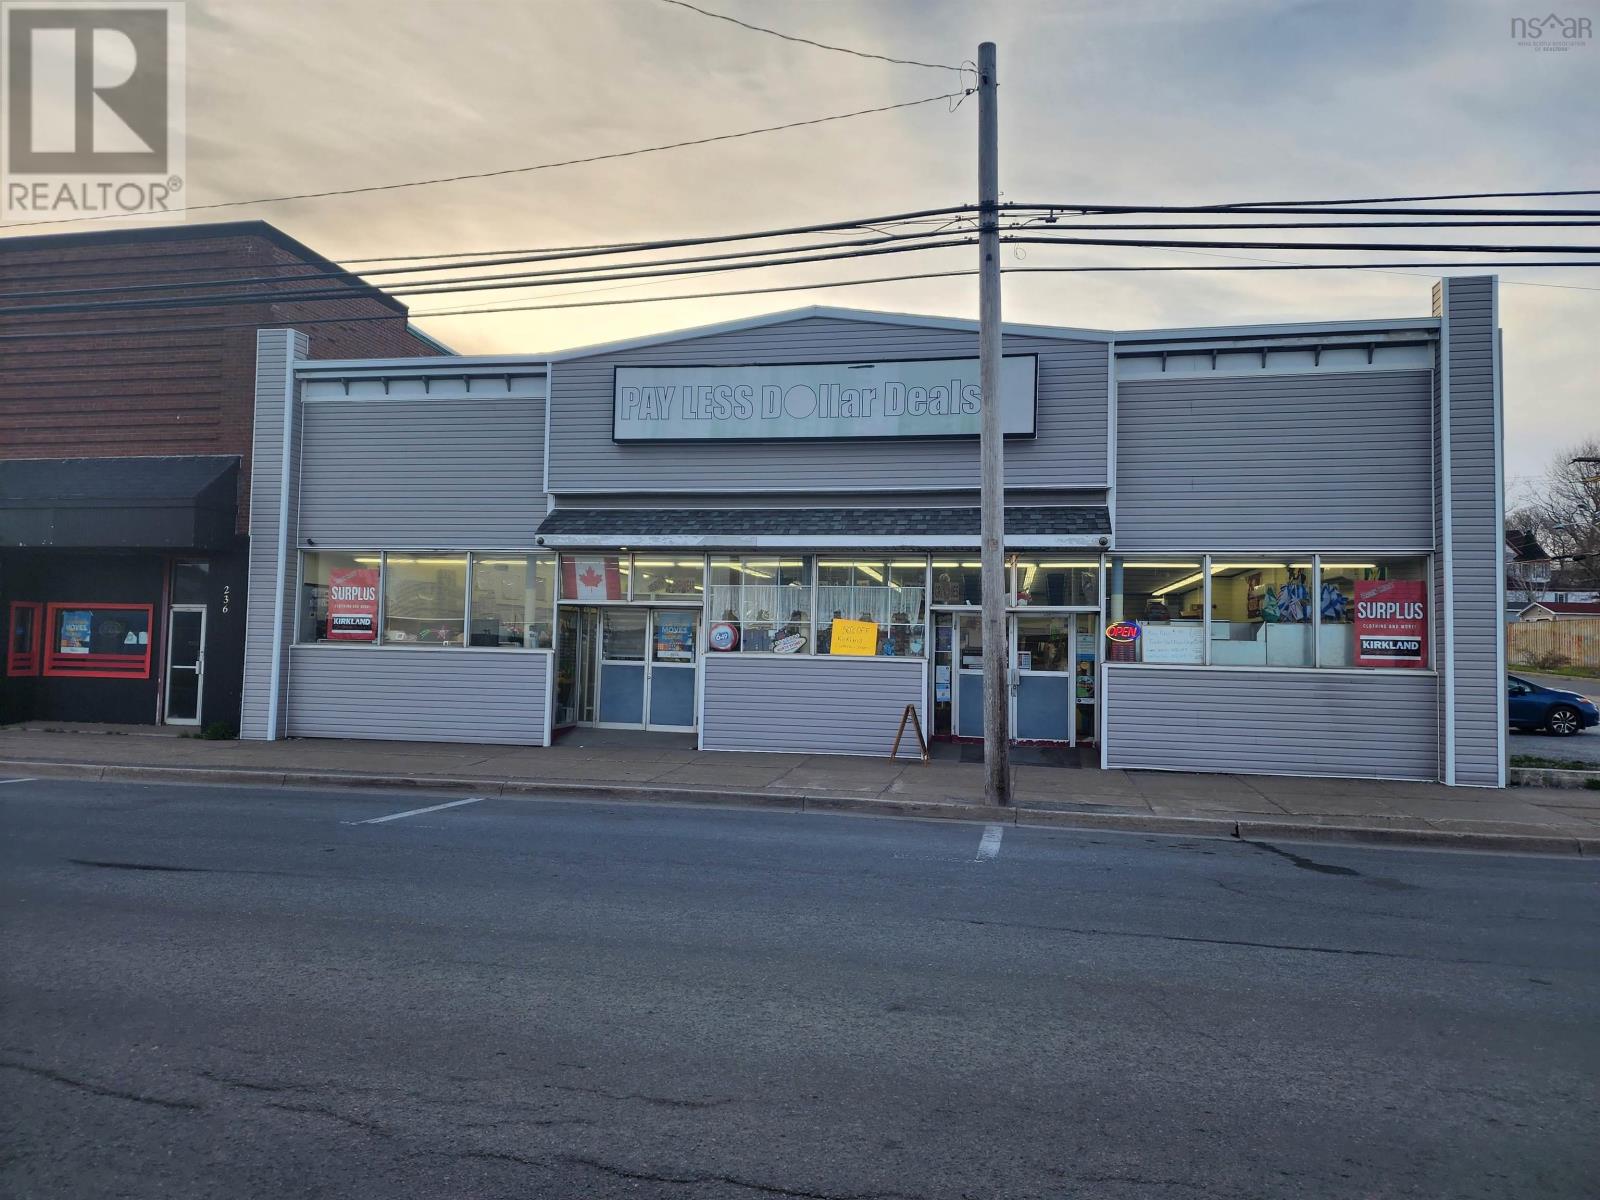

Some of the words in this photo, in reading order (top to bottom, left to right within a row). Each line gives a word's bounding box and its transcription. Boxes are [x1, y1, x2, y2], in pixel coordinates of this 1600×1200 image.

[620, 386, 676, 421] PAY
[681, 384, 754, 421] LESS
[883, 379, 982, 417] Deals
[222, 585, 230, 614] 236
[331, 586, 376, 601] SURPLUS
[1357, 601, 1424, 620] SURPLUS
[333, 617, 371, 626] KIRKLAND
[1108, 626, 1138, 637] OPEN
[1362, 640, 1419, 650] KIRKLAND
